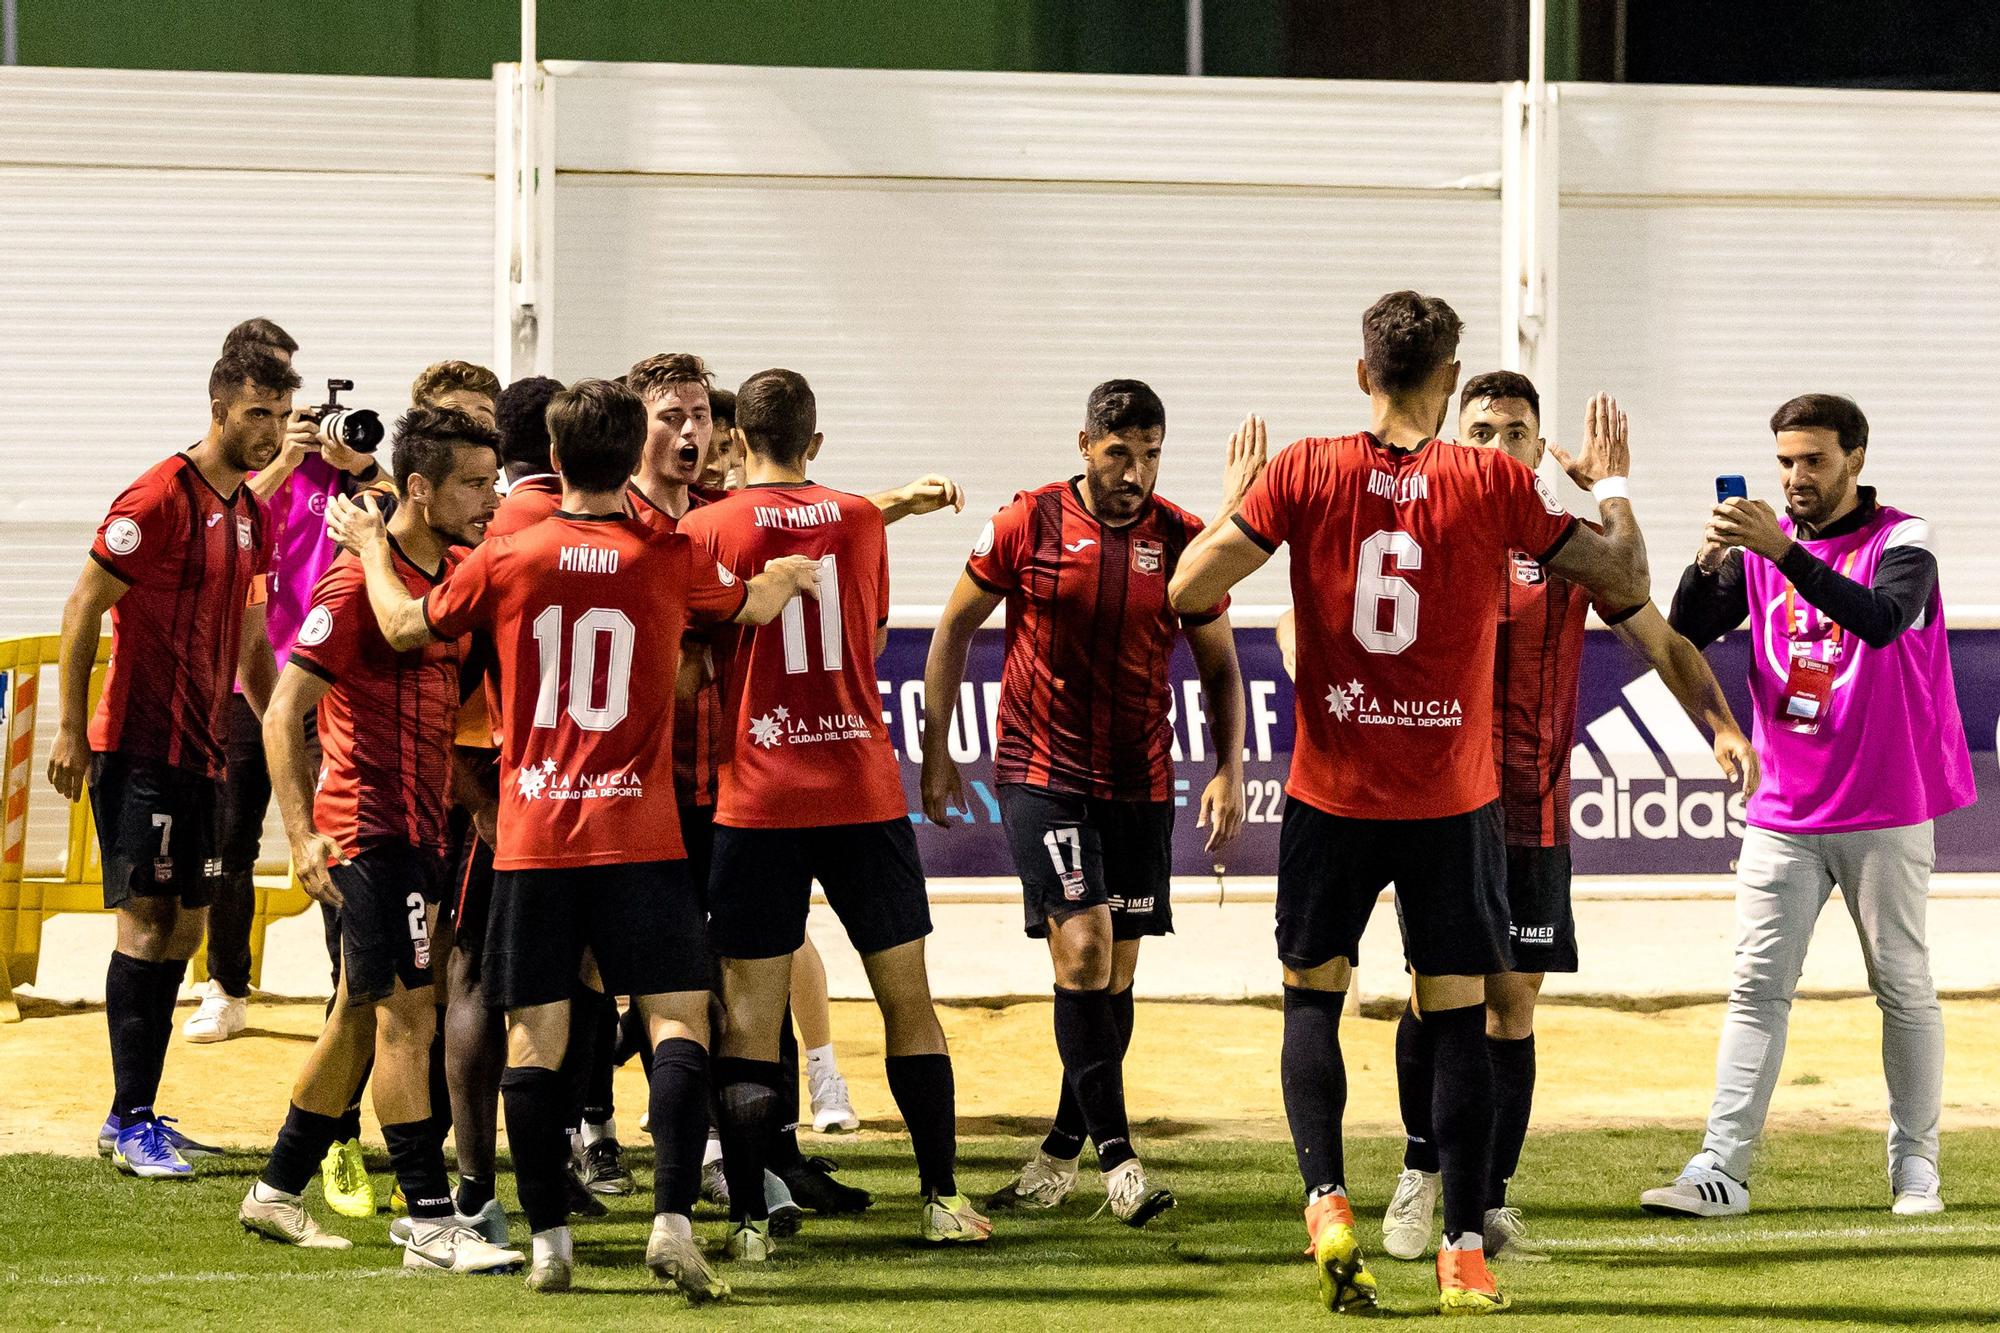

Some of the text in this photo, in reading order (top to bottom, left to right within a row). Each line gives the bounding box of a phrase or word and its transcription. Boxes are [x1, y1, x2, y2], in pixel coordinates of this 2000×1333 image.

[753, 506, 783, 529] JAVI
[784, 499, 842, 529] MARTÍN
[558, 543, 620, 575] MIÑANO
[1352, 529, 1422, 655] 6
[781, 553, 843, 675] 11
[532, 604, 636, 732] 10
[1360, 696, 1380, 713] LA
[787, 717, 808, 734] LA
[1358, 714, 1463, 728] CIUDAD DEL DEPORTE
[788, 729, 872, 745] CIUDAD DEL DEPORTE
[550, 773, 570, 789] LA
[548, 787, 643, 800] CIUDAD DEL DEPORTE
[151, 813, 173, 857] 7
[1042, 827, 1082, 875] 17
[1127, 896, 1154, 908] IMED
[406, 892, 428, 940] 2
[1520, 927, 1554, 938] IMED
